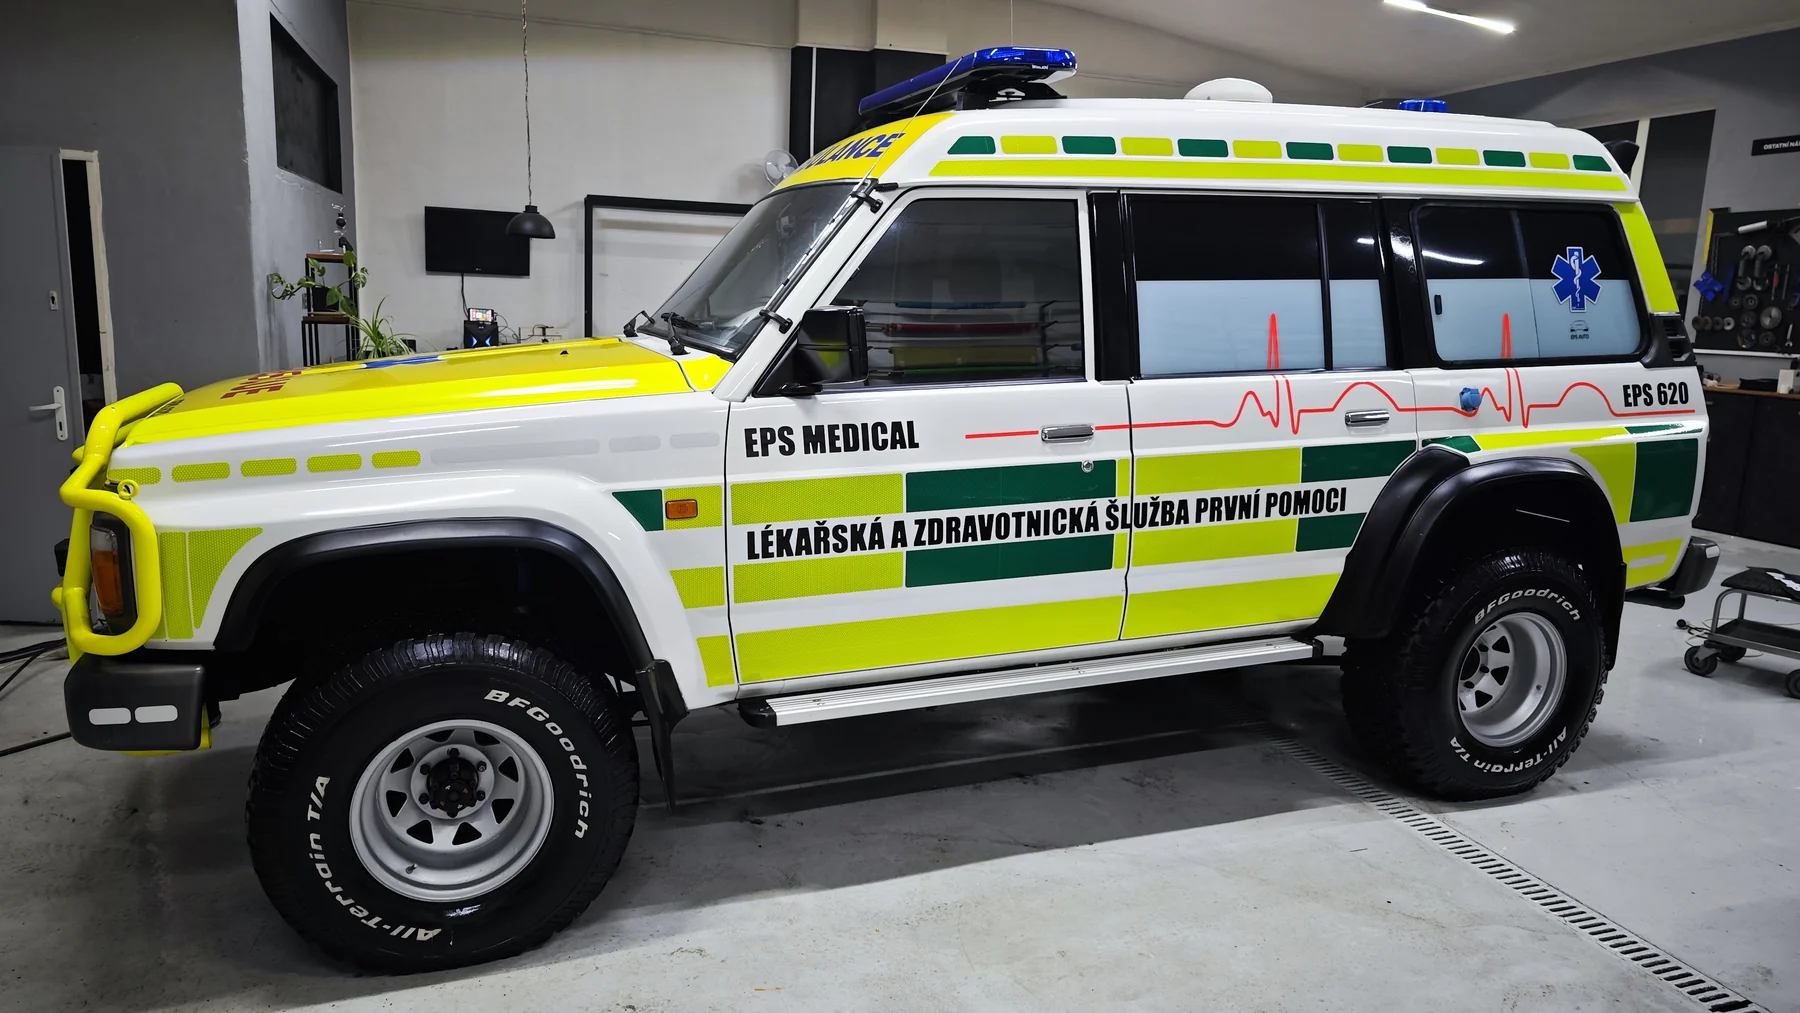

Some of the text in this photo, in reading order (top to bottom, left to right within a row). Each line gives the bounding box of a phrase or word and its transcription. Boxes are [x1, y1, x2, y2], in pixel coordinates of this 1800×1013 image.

[1622, 381, 1690, 407] EPS 620
[744, 420, 920, 458] EPS MEDICAL
[747, 487, 1348, 560] LÉKAŘSKÁ A ZDRAVOTNICKÁ ŠLUŽBA PRVNÍ POMOCI
[1474, 588, 1581, 625] BFGoodrich
[484, 689, 592, 839] BFGoodrich
[1449, 725, 1567, 773] All-Terrain T/A
[307, 775, 442, 942] All-Terrain T/A
